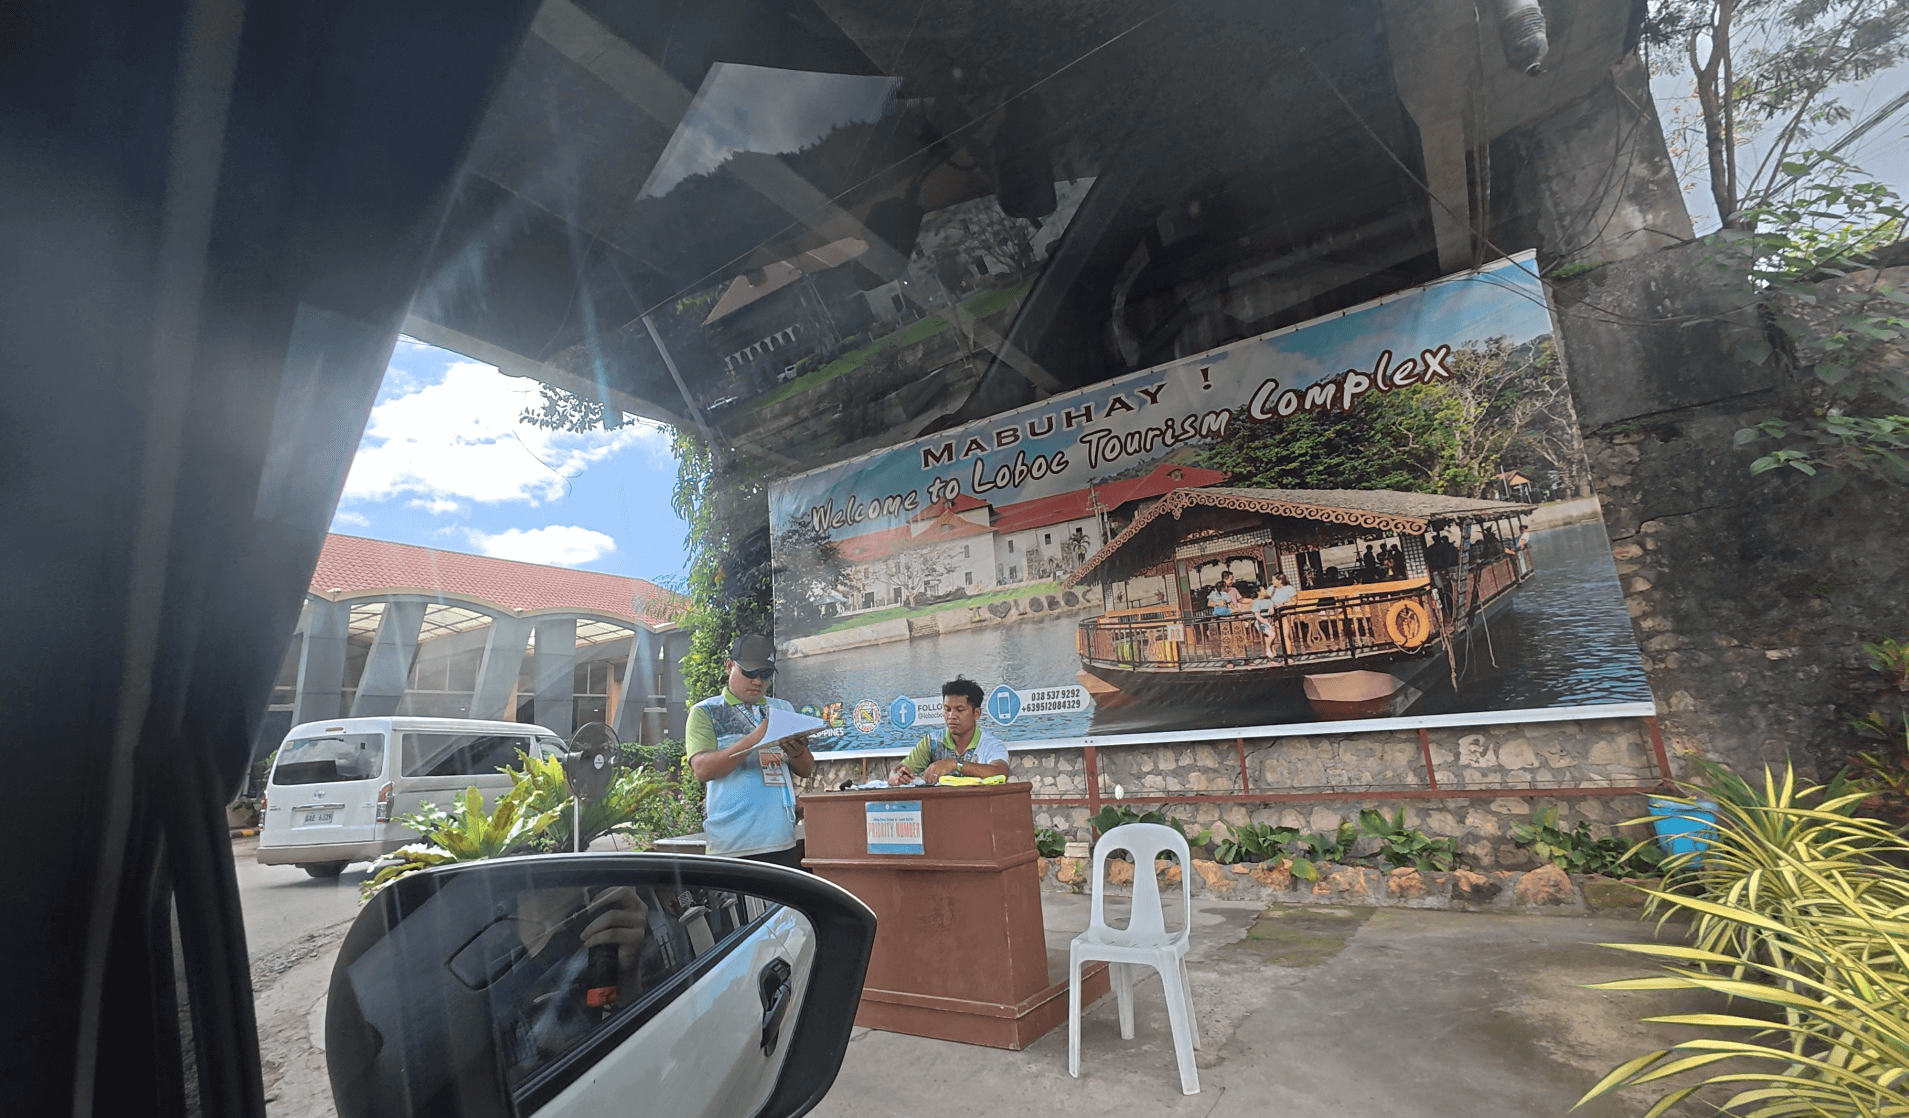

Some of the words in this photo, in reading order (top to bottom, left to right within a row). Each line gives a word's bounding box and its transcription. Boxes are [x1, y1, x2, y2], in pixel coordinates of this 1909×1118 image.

[922, 382, 1167, 468] MABUHAY
[1199, 366, 1212, 390] !
[811, 489, 919, 534] Welcome
[927, 475, 961, 505] to
[971, 451, 1069, 494] Loboc
[1079, 408, 1233, 468] Tourism
[1250, 344, 1452, 423] Complex
[1031, 692, 1045, 701] 038
[1046, 690, 1060, 700] 537
[1061, 688, 1080, 699] 9292
[917, 703, 943, 712] FOLLO
[1021, 699, 1081, 712] +639512084329
[868, 822, 894, 838] PRIORITY
[895, 821, 921, 838] NUMBER
